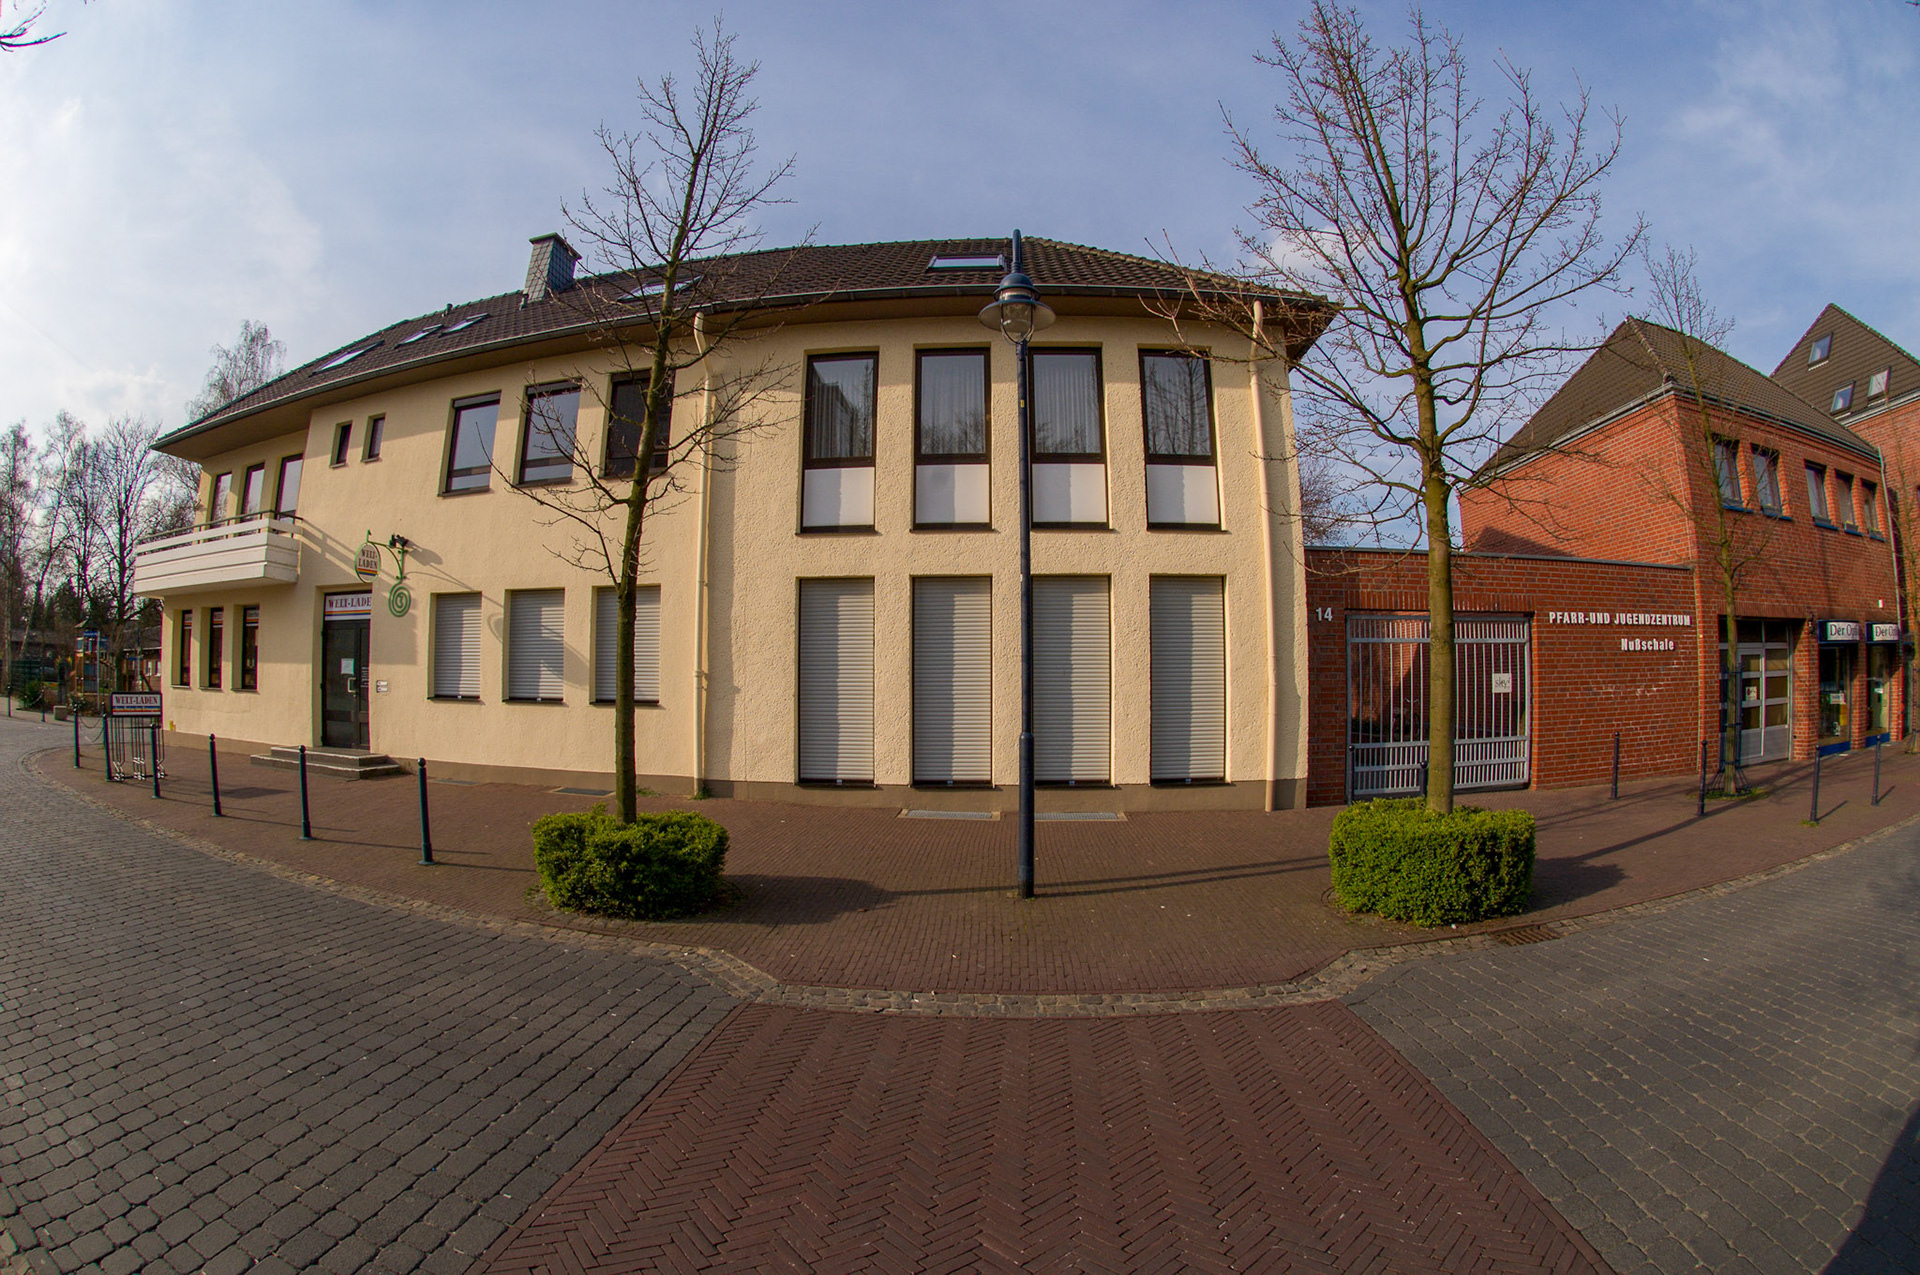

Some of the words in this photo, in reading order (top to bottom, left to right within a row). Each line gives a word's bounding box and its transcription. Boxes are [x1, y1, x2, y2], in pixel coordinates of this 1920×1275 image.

[358, 557, 377, 569] LADEN
[328, 597, 371, 608] WELT-LADE
[1315, 607, 1333, 621] 14
[1549, 612, 1611, 624] PFARR-UND
[1614, 613, 1691, 625] JUGENDZENTRUM
[1830, 624, 1845, 636] Der
[1875, 626, 1887, 637] Der
[1621, 638, 1675, 650] Nußschale
